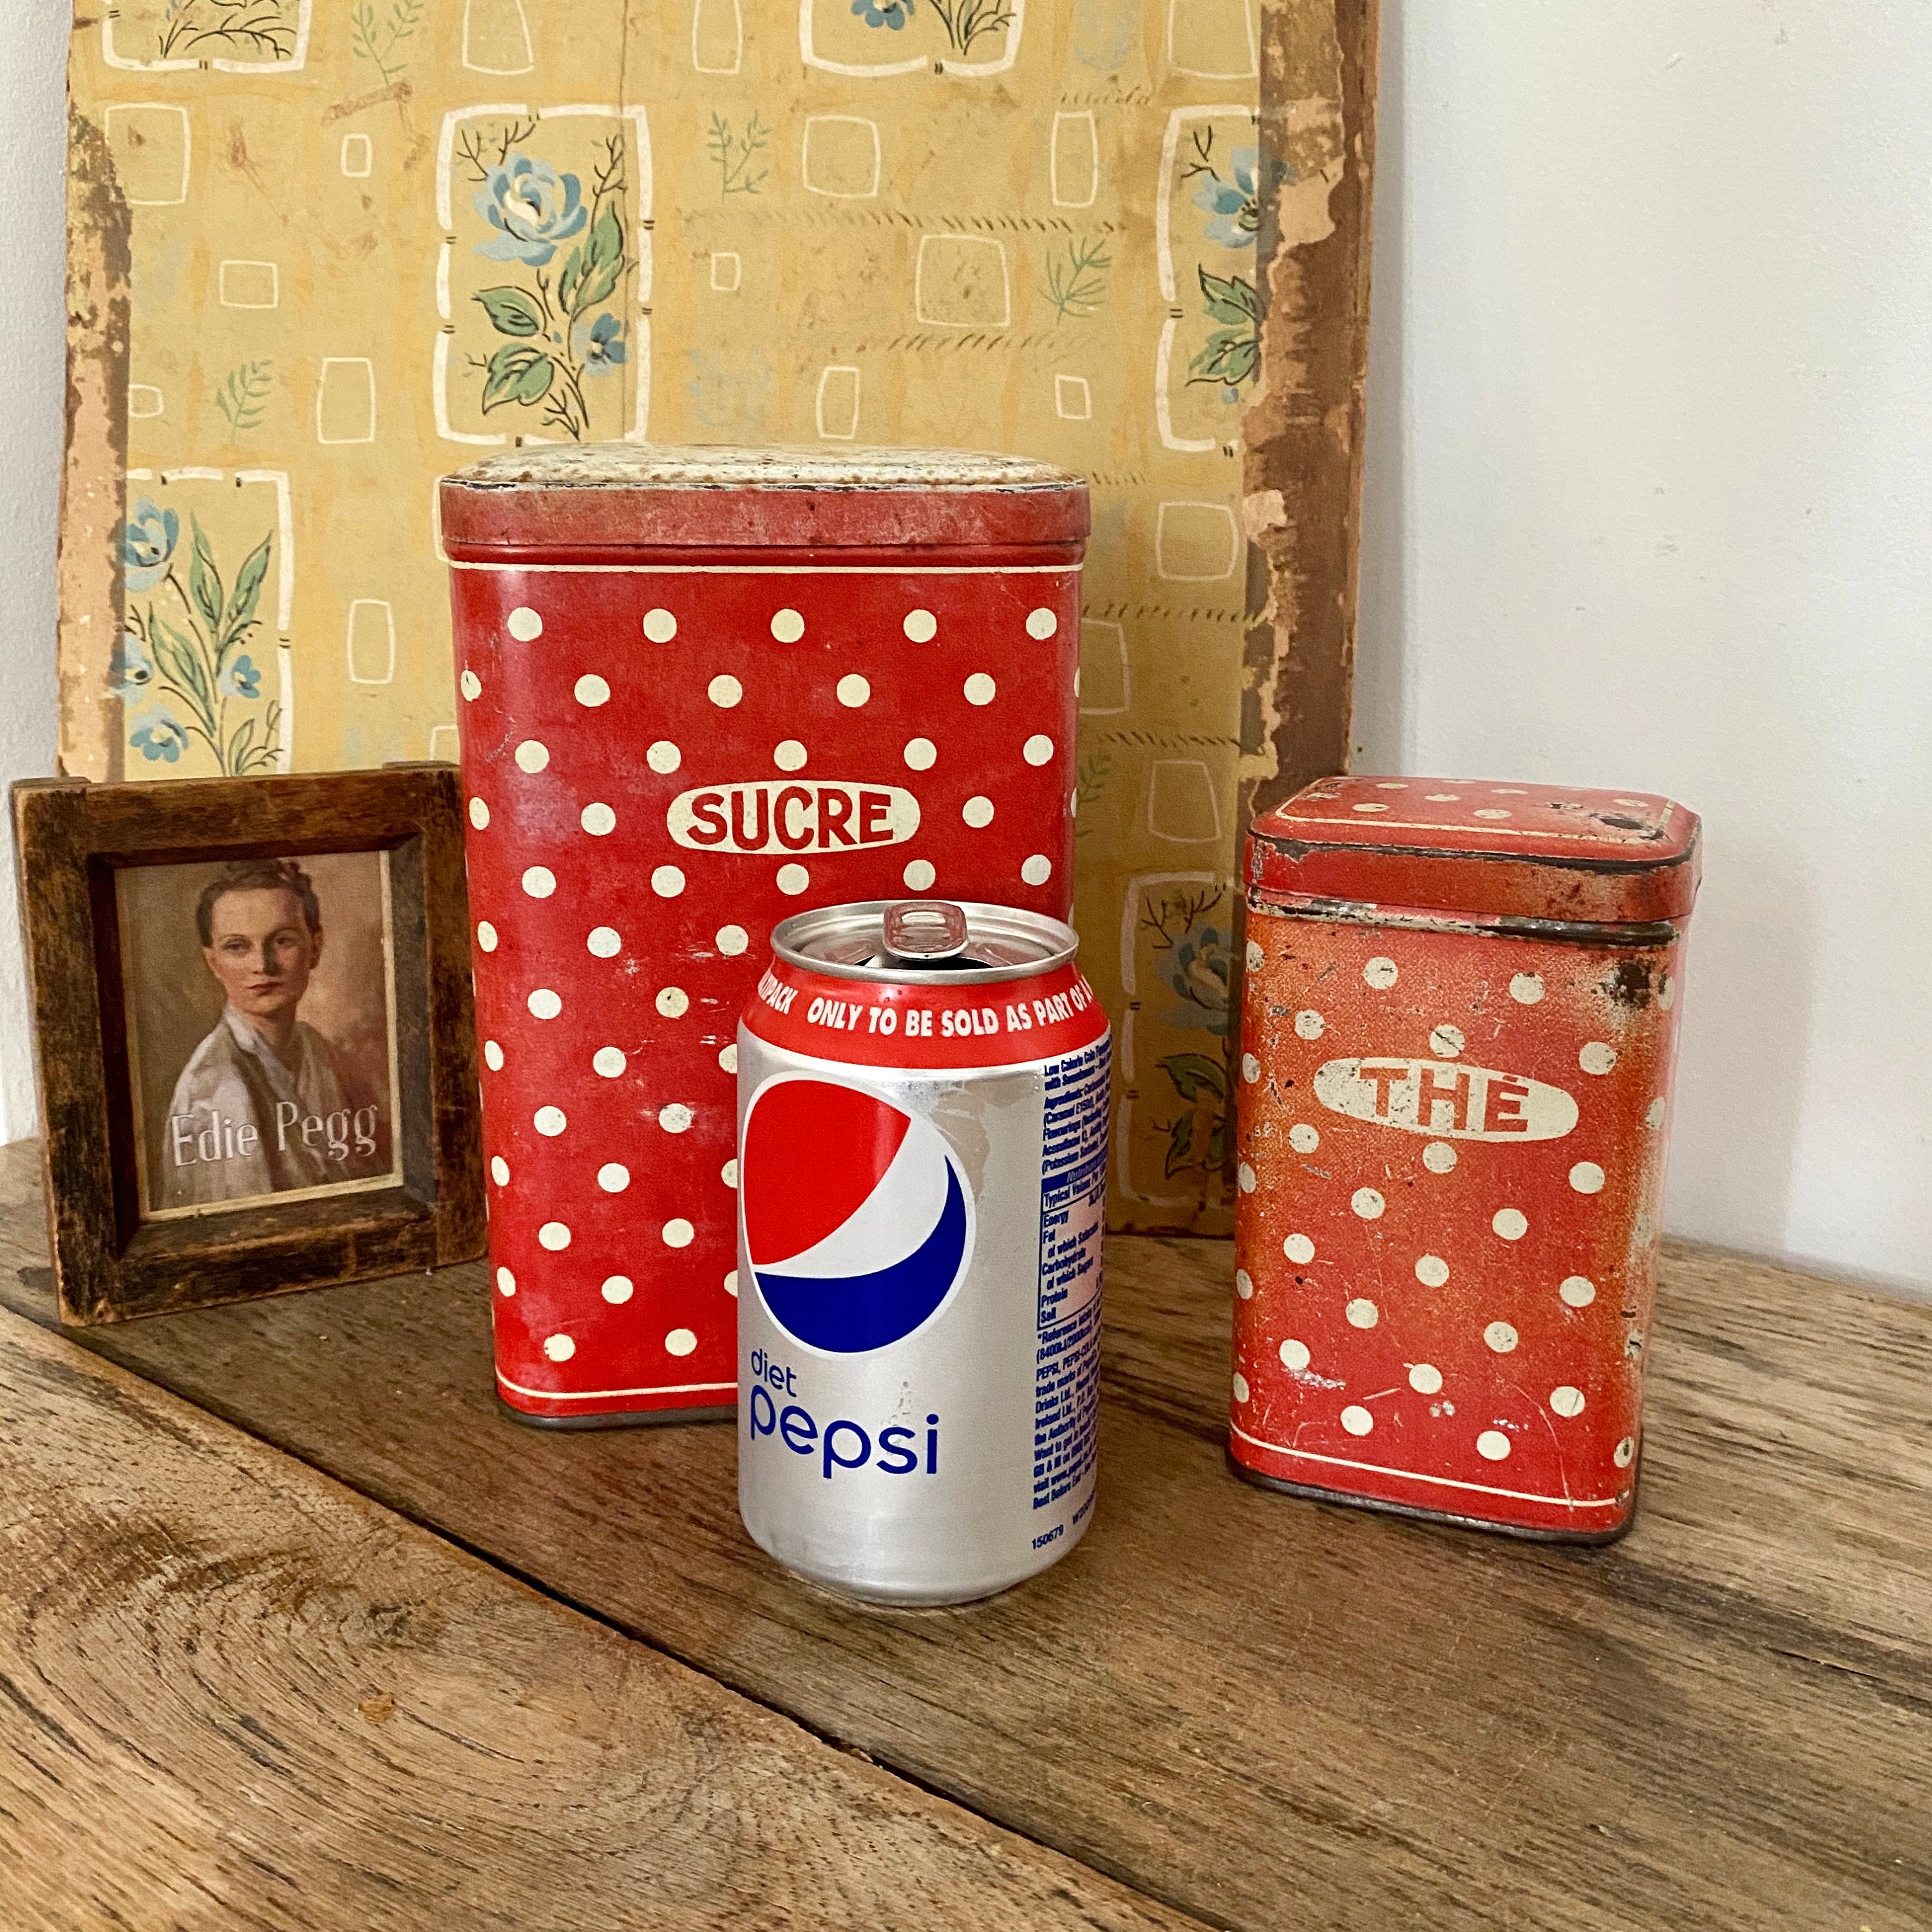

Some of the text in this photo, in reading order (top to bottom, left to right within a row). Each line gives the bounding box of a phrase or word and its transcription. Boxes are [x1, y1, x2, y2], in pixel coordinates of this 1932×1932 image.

[687, 786, 894, 851] SUCRE
[807, 997, 863, 1030] ONLY
[869, 1007, 897, 1036] TO
[905, 1009, 933, 1036] BE
[941, 1007, 998, 1037] SOLD
[1006, 1004, 1032, 1032] AS
[1032, 992, 1074, 1027] PART
[1069, 984, 1087, 1011] OF
[171, 1101, 377, 1167] Edie Pegg
[1043, 1228, 1056, 1244] Fat
[1041, 1307, 1057, 1323] Salt
[751, 1348, 797, 1397] diet
[750, 1384, 940, 1480] pepsi
[1032, 1524, 1064, 1550] 150679
